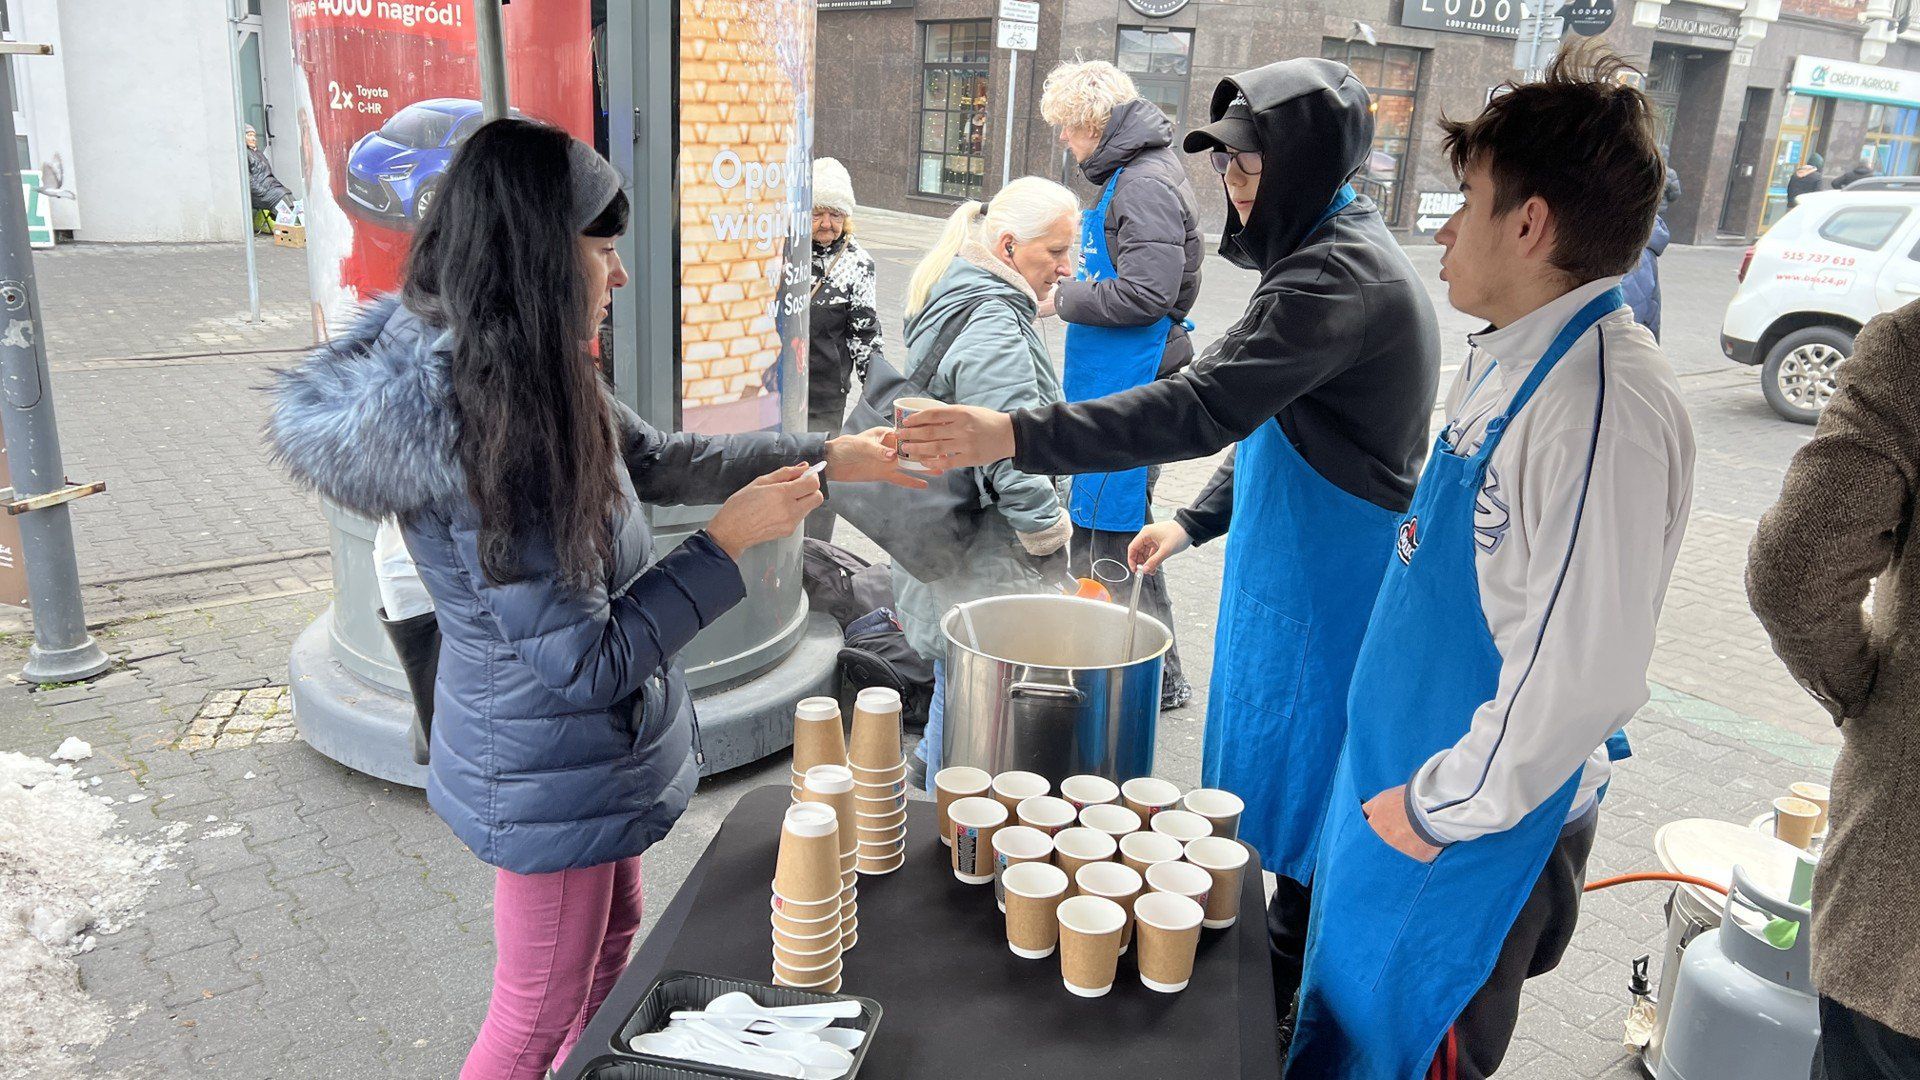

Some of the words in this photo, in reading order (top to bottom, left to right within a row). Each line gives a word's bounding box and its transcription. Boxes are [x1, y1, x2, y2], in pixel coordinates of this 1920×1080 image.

[318, 0, 372, 17] 4000
[377, 1, 462, 27] nagród!
[356, 84, 389, 99] Toyota
[1860, 78, 1900, 92] AGRICOLE
[328, 80, 354, 110] 2x
[357, 101, 382, 114] C-HR
[1782, 251, 1805, 261] 515
[1807, 253, 1830, 263] 737
[1832, 256, 1855, 266] 619
